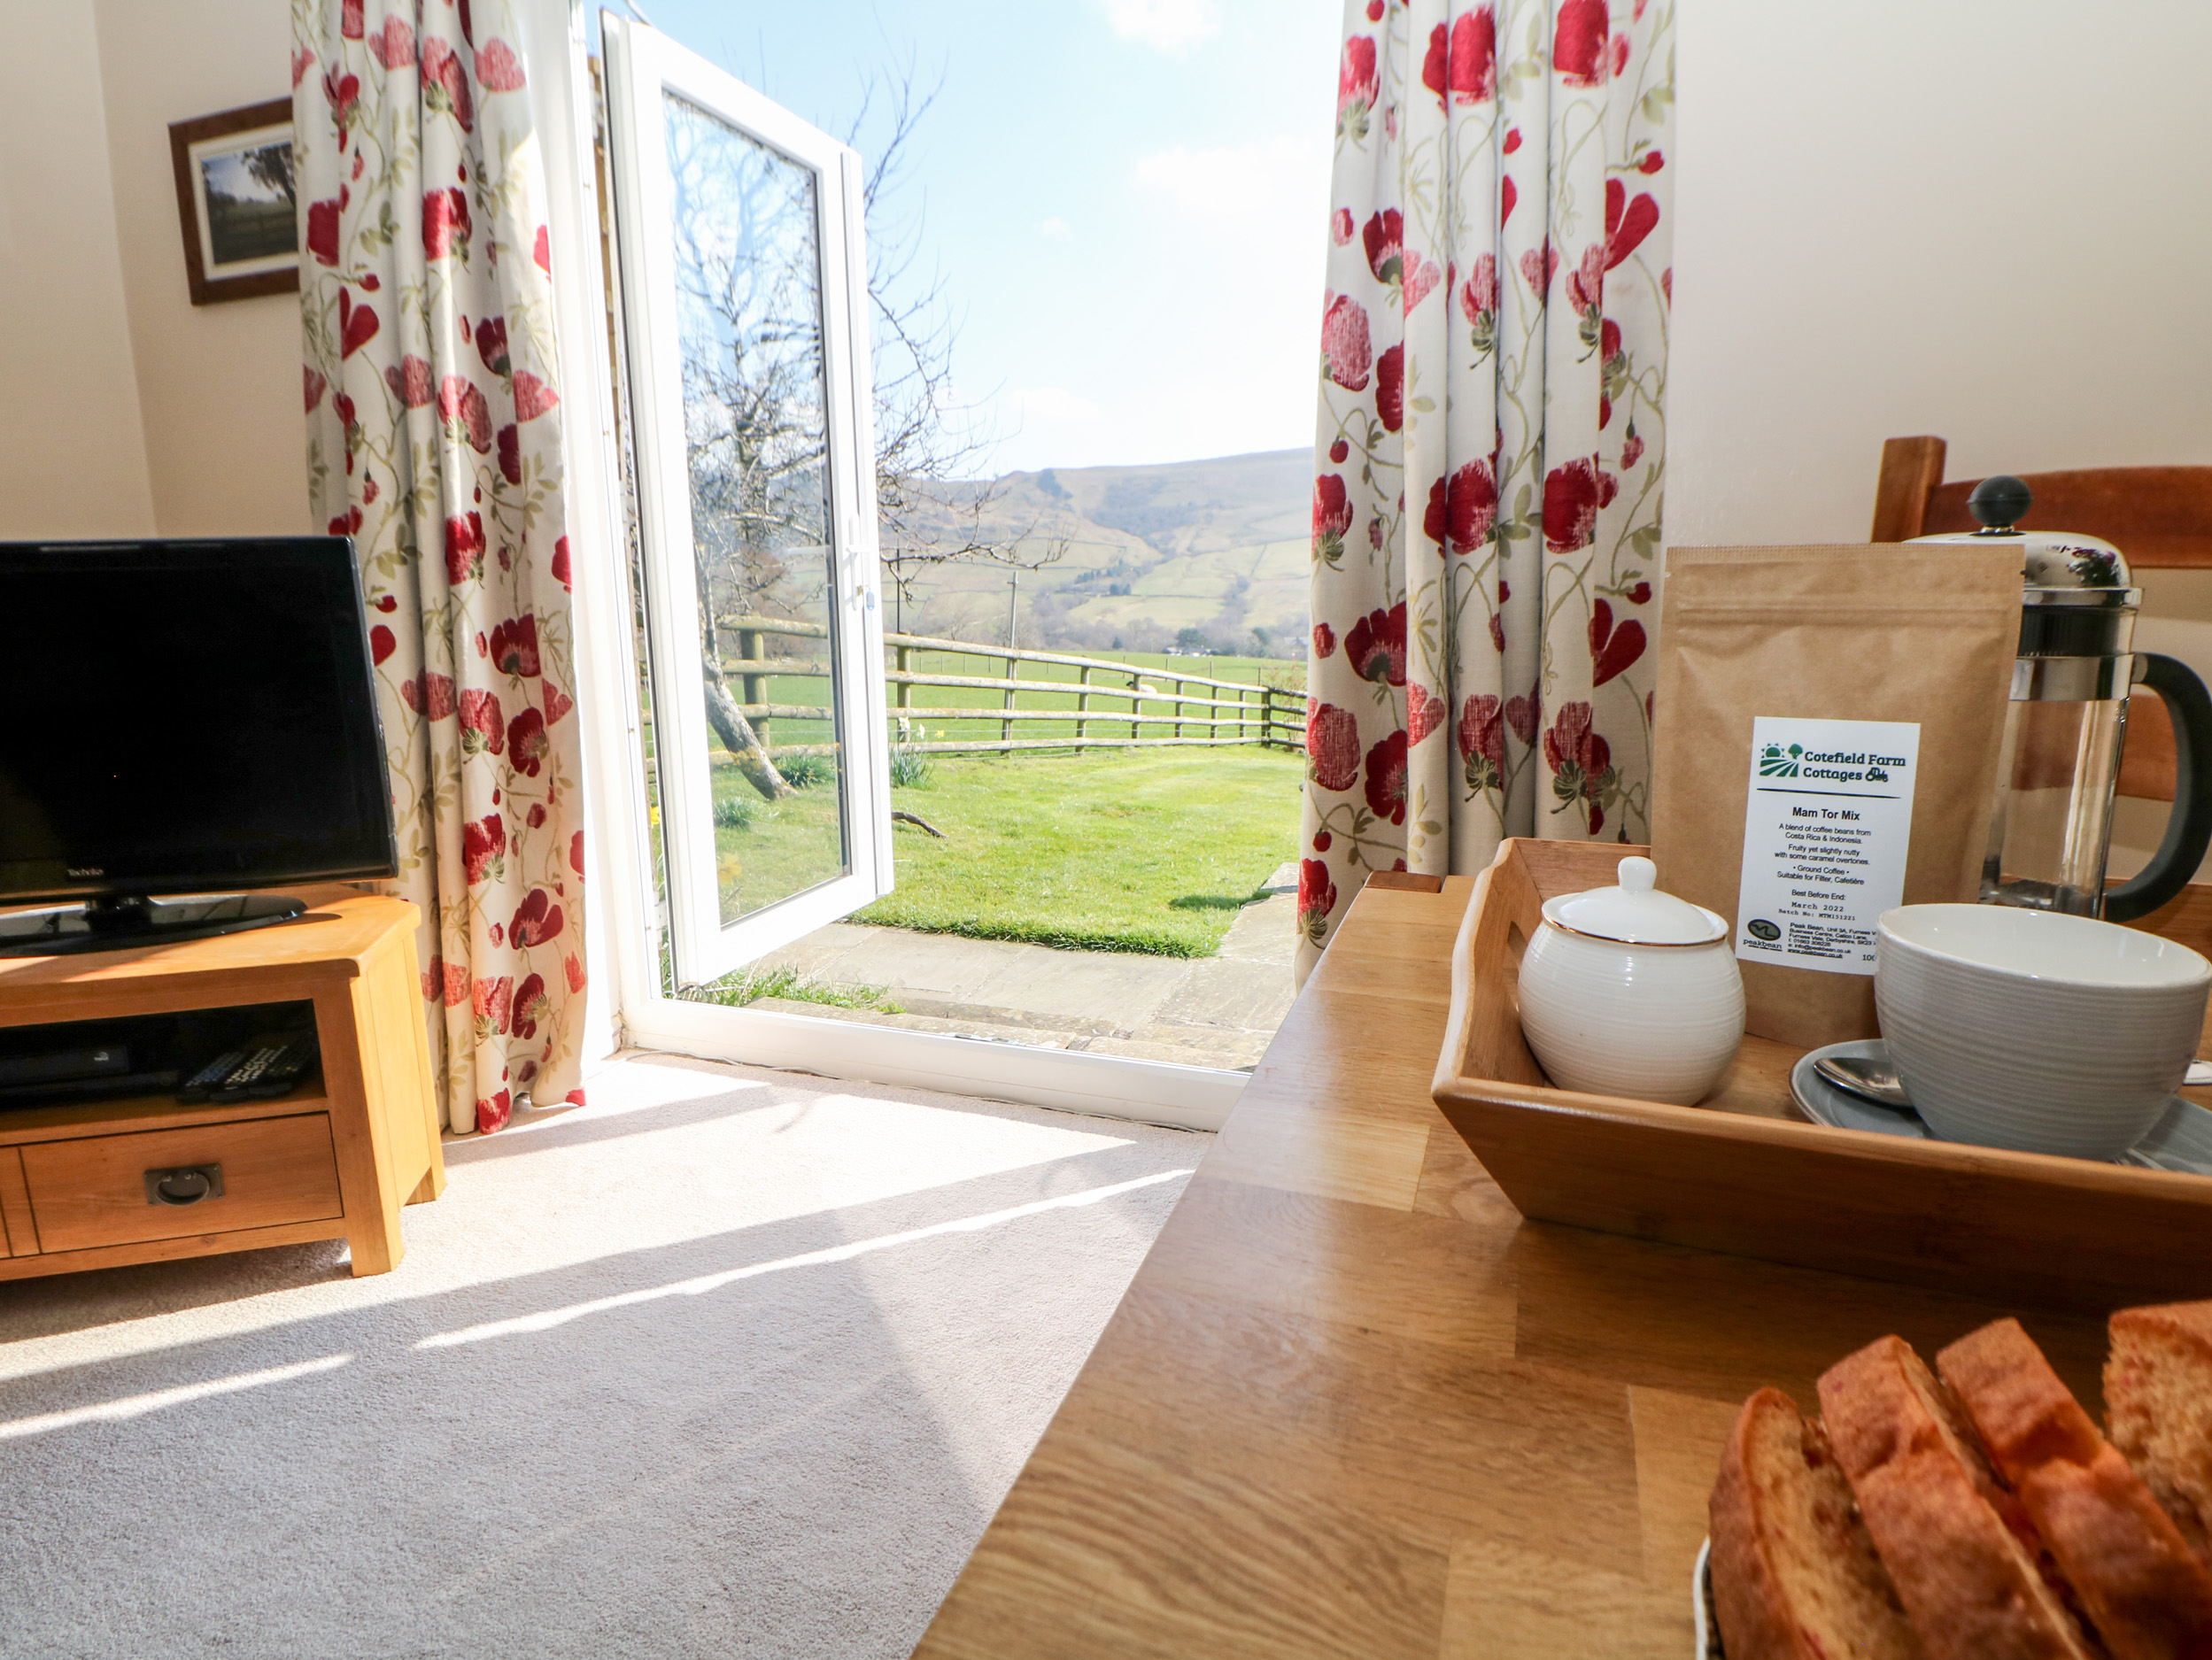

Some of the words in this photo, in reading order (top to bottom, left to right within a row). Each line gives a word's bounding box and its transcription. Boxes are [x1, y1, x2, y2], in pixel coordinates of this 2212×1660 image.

[1805, 752, 1865, 765] Cotefield
[1868, 754, 1906, 767] Farm
[1803, 768, 1862, 782] Cottages
[1792, 807, 1818, 818] Mam
[1821, 808, 1838, 819] Tor
[1841, 810, 1860, 821] Mix
[1789, 844, 1806, 853] Fruity
[1844, 848, 1860, 857] nutty
[1836, 856, 1870, 865] overtones.
[1776, 871, 1803, 880] Suitable
[1791, 901, 1818, 910] March
[1743, 938, 1782, 948] peakbean
